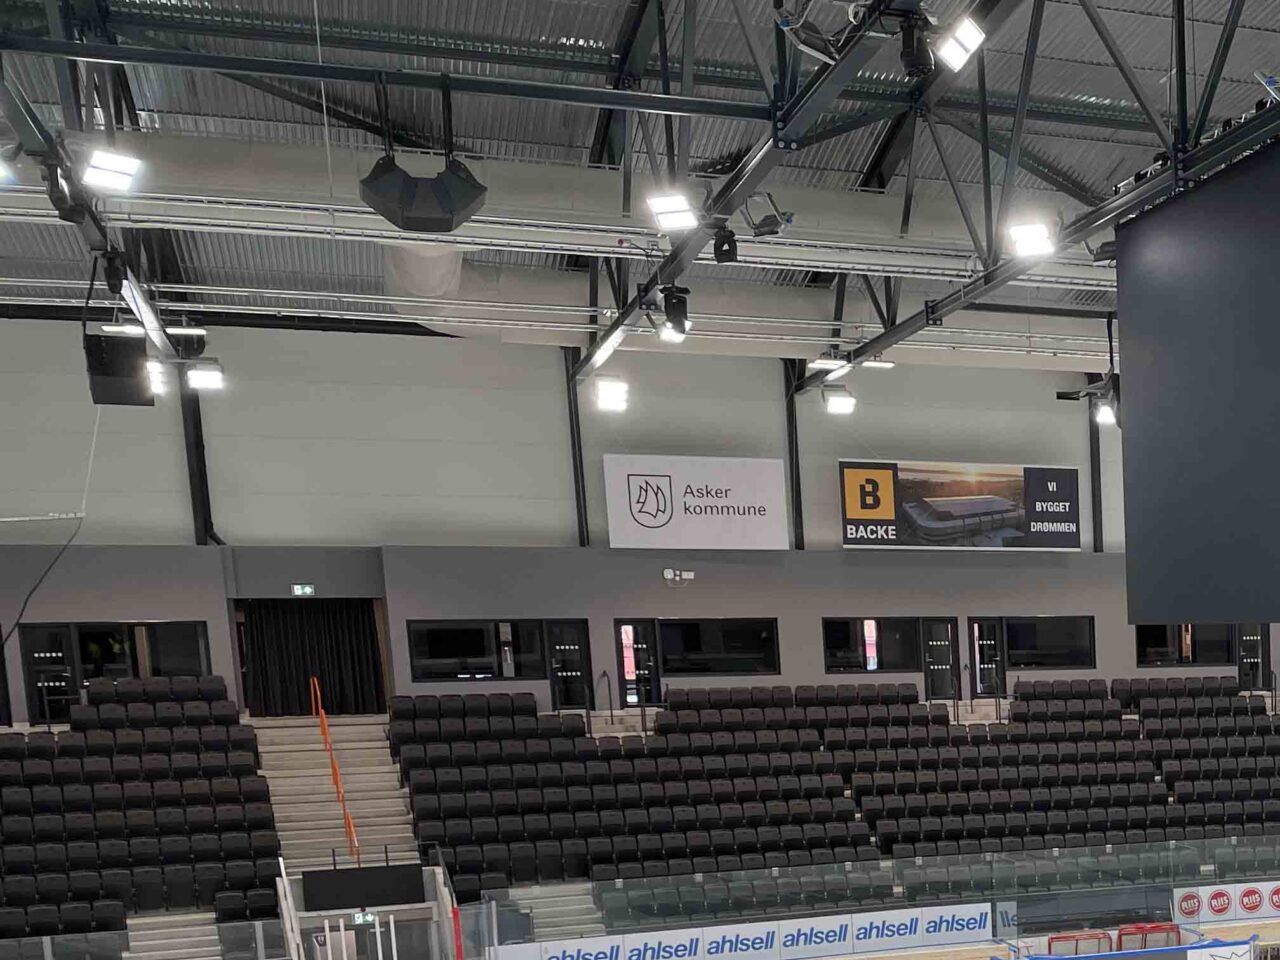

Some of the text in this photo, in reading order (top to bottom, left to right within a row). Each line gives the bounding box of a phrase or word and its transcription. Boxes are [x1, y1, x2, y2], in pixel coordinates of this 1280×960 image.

[683, 484, 732, 499] Asker
[859, 478, 881, 510] B
[1047, 481, 1057, 492] VI
[683, 500, 766, 516] kommune
[1035, 501, 1070, 512] BYGGET
[846, 524, 897, 540] BACKE
[1030, 522, 1077, 533] DRØMMEN
[1181, 899, 1200, 910] RIIS
[1210, 896, 1228, 908] RIIS
[1242, 894, 1261, 906] RIIS
[707, 931, 776, 955] ahlsell
[782, 924, 849, 948] ahlsell
[855, 917, 919, 941] ahlsell
[925, 912, 988, 934] ahlsell
